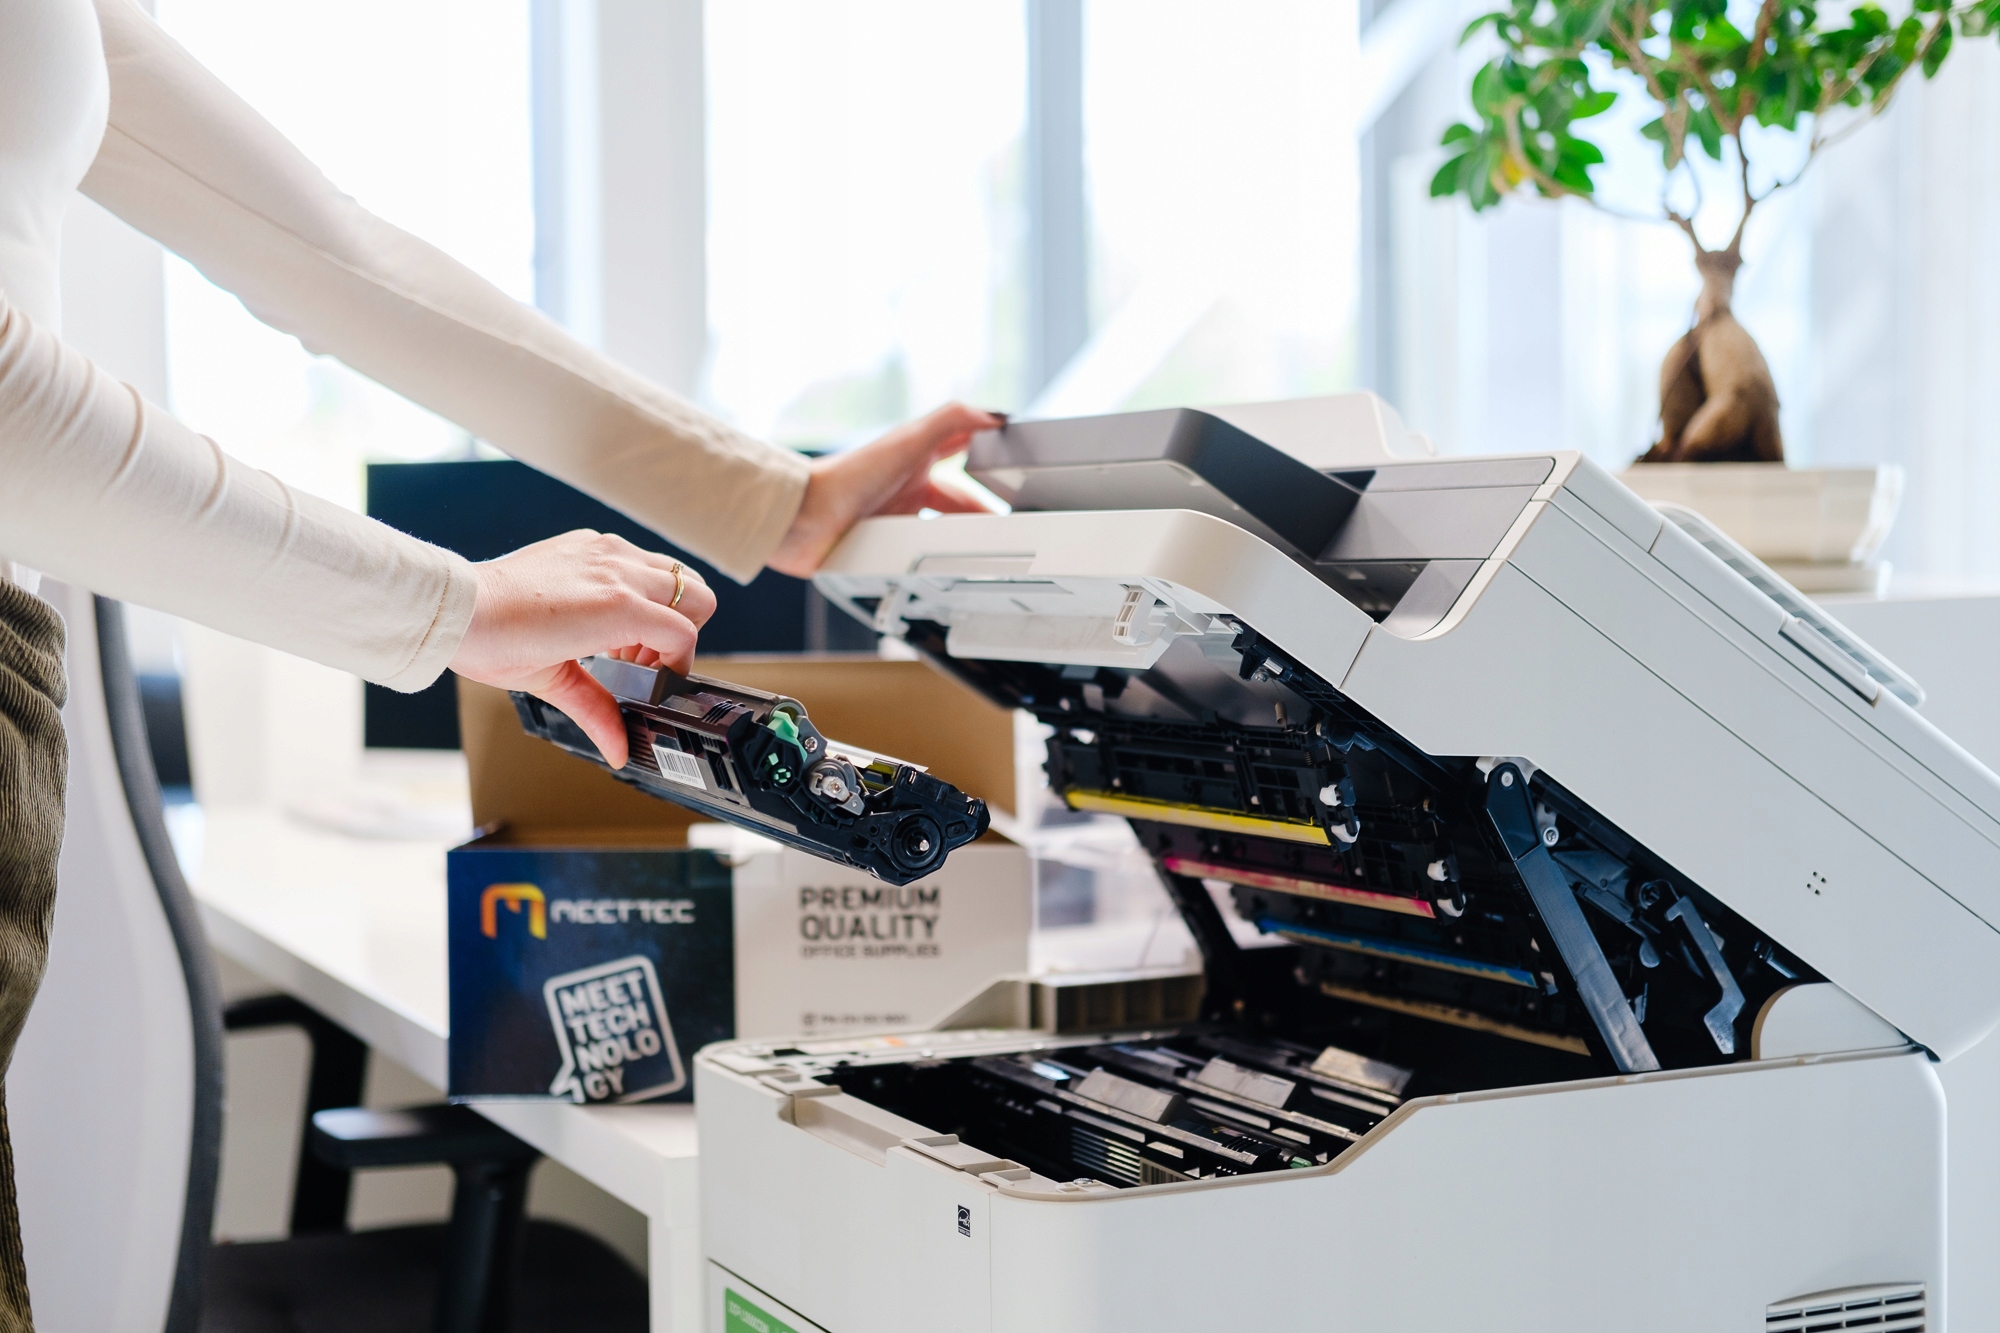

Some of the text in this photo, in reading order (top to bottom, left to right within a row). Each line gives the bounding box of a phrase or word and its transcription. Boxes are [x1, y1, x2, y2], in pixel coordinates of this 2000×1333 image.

[801, 886, 941, 910] PREMIUM
[801, 914, 940, 941] QUALITY
[863, 946, 940, 959] SUPPLIES
[558, 971, 643, 1016] MEET
[566, 1001, 651, 1044] TECH
[575, 1029, 661, 1073] NOLO
[584, 1068, 624, 1100] GY
